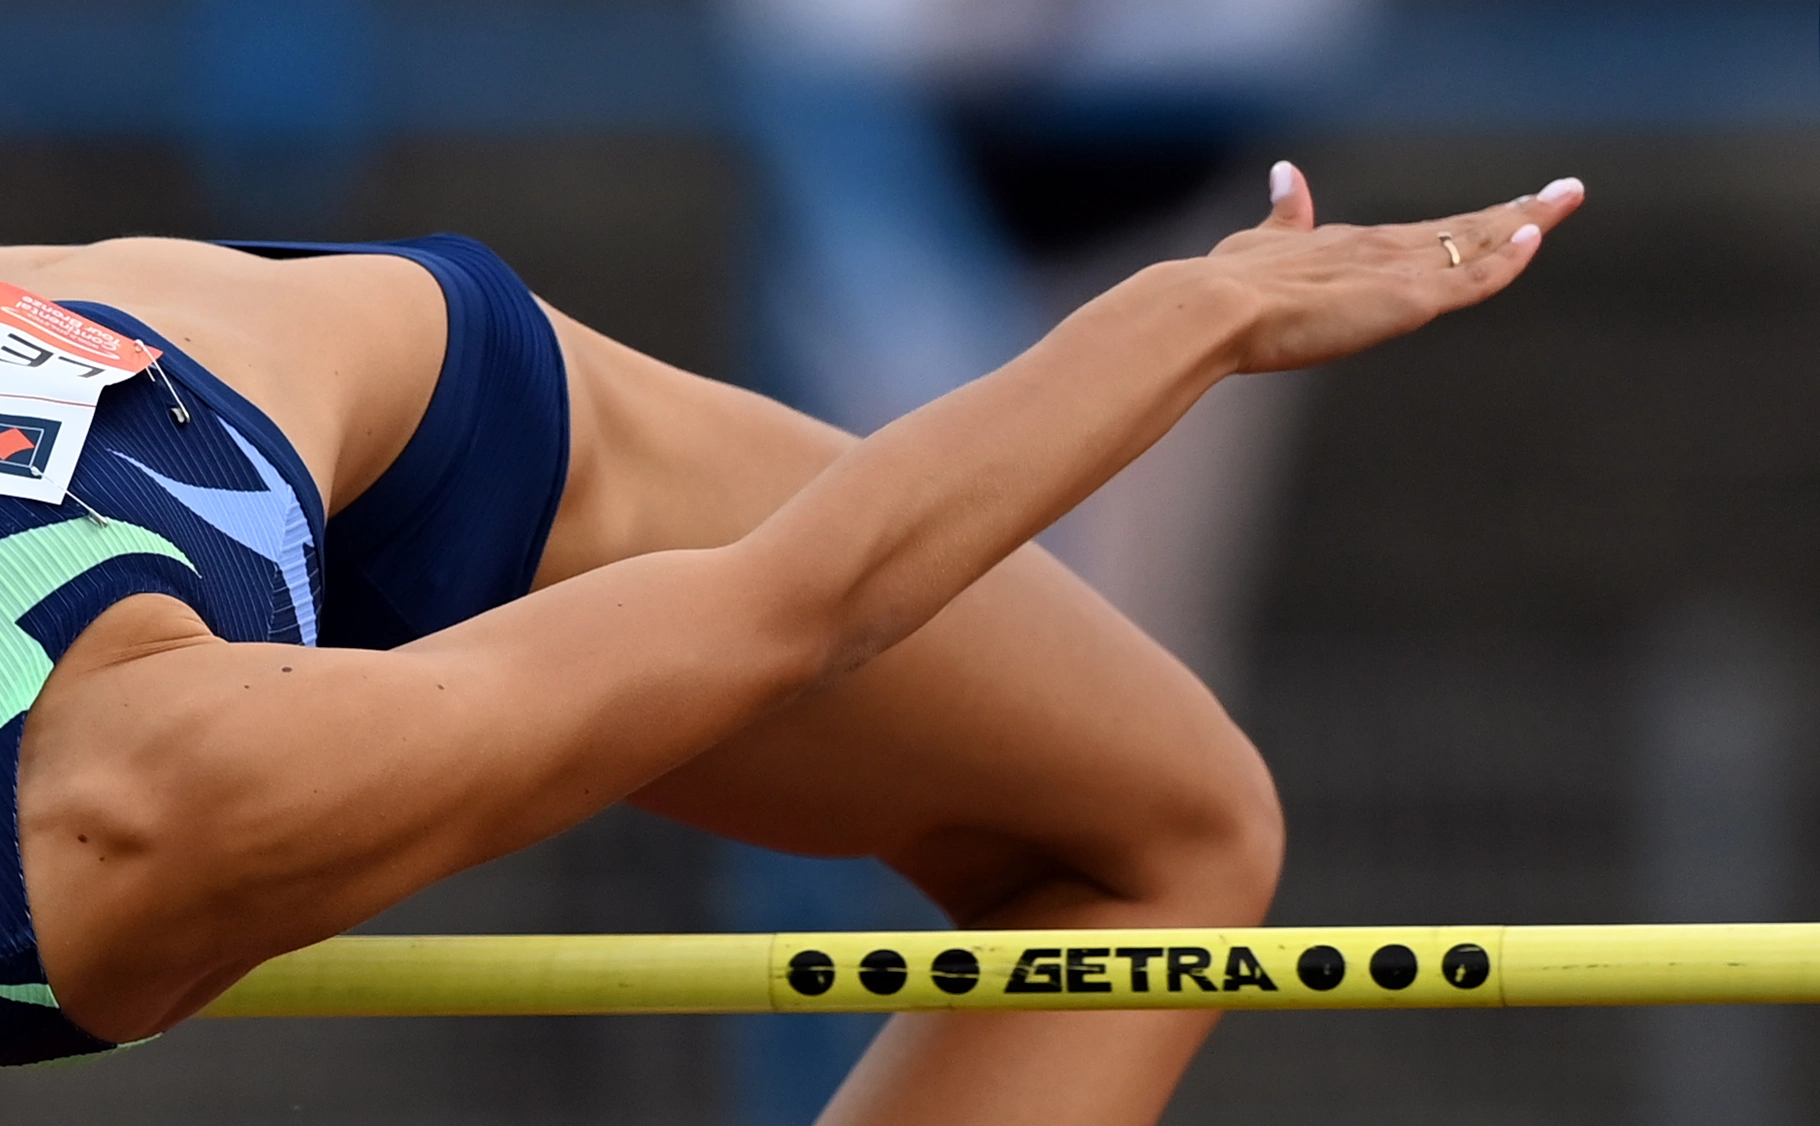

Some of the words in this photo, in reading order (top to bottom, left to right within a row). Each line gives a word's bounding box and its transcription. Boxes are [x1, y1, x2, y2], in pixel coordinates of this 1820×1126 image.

[16, 301, 117, 351] Continental
[22, 296, 83, 328] Bronze
[85, 325, 121, 347] Tour
[1004, 946, 1279, 993] GETRA
